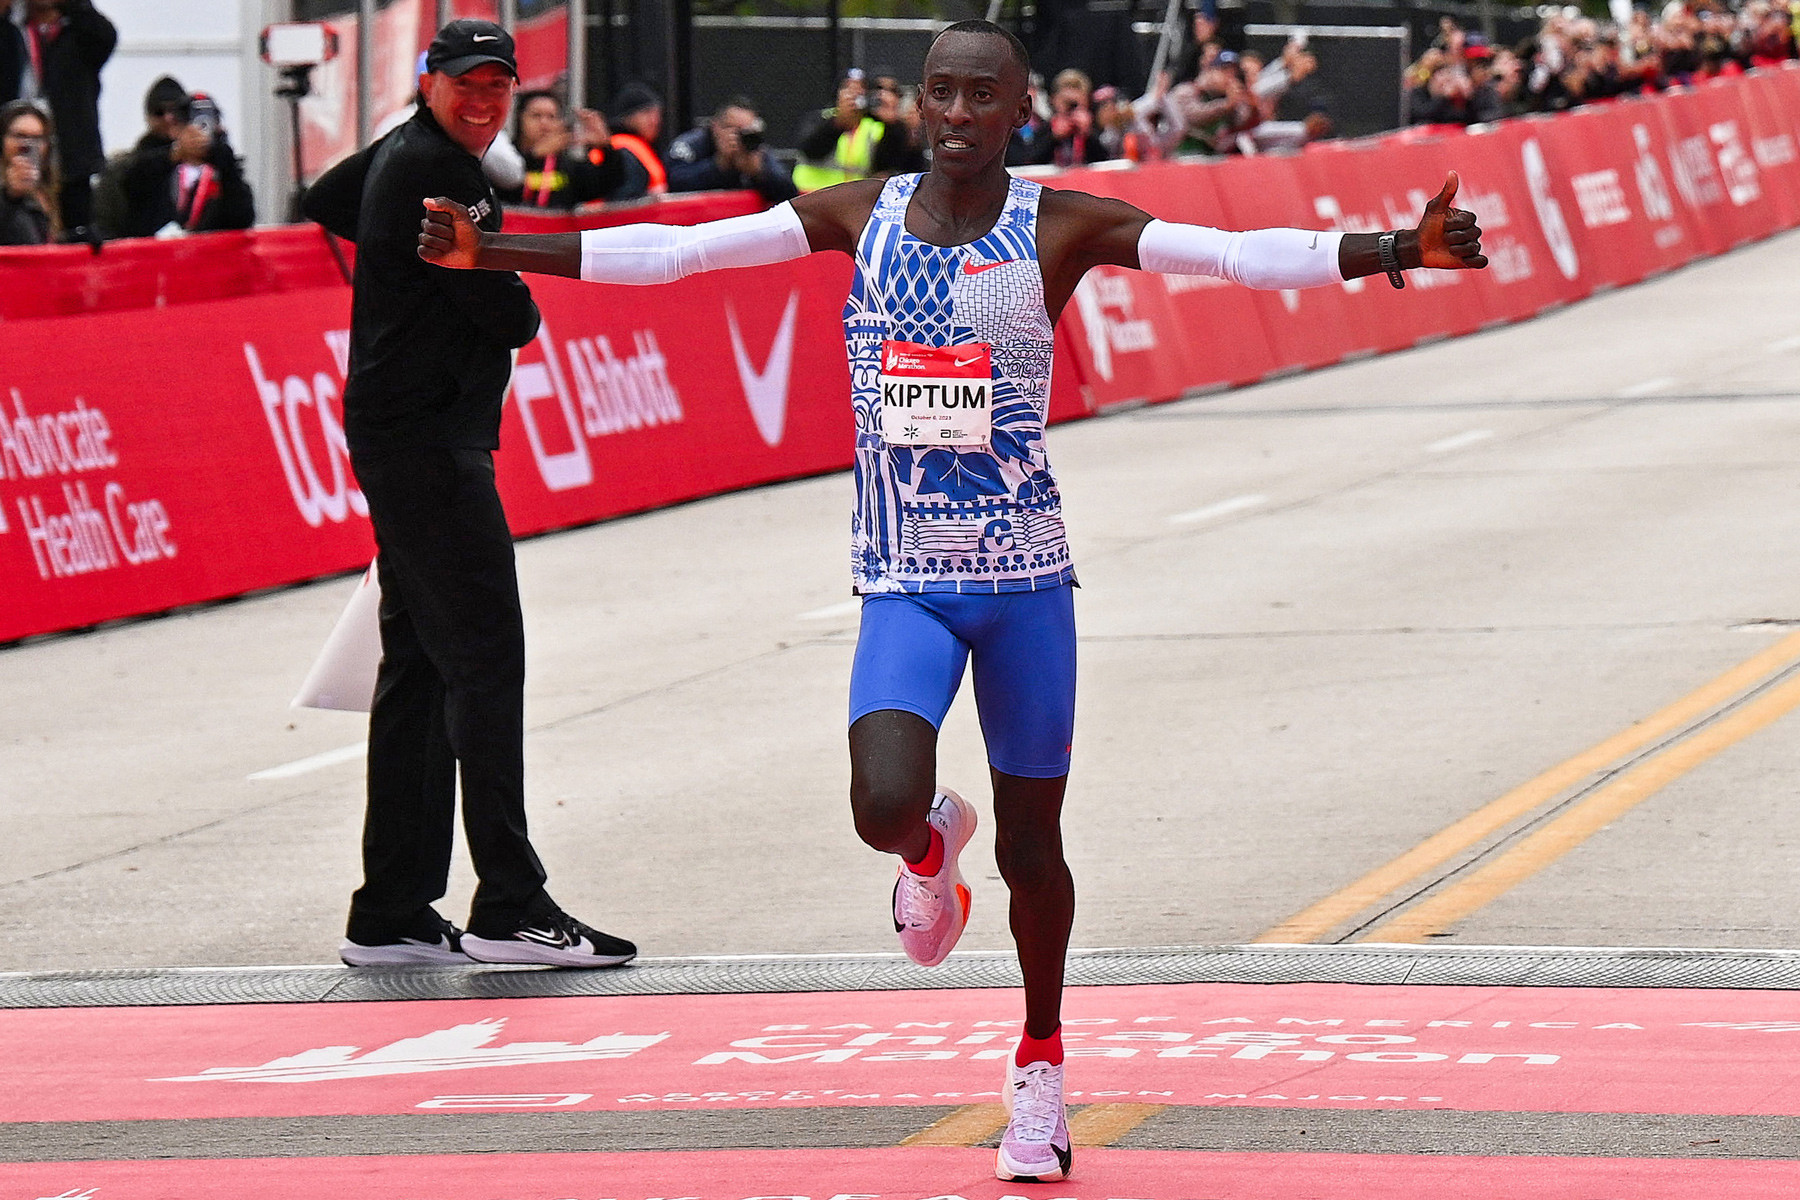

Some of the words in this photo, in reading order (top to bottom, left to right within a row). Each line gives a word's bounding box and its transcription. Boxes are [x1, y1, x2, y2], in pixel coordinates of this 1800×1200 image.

[565, 328, 684, 438] Abbott
[884, 383, 985, 409] KIPTUM
[0, 387, 118, 480] Advocate
[16, 480, 120, 580] Health
[105, 481, 177, 565] Care
[762, 1020, 1025, 1031] BANK
[1061, 1016, 1176, 1026] OF
[1202, 1017, 1644, 1030] AMERICA
[838, 1091, 1174, 1099] MARAON
[1204, 1093, 1443, 1102] MAJORS
